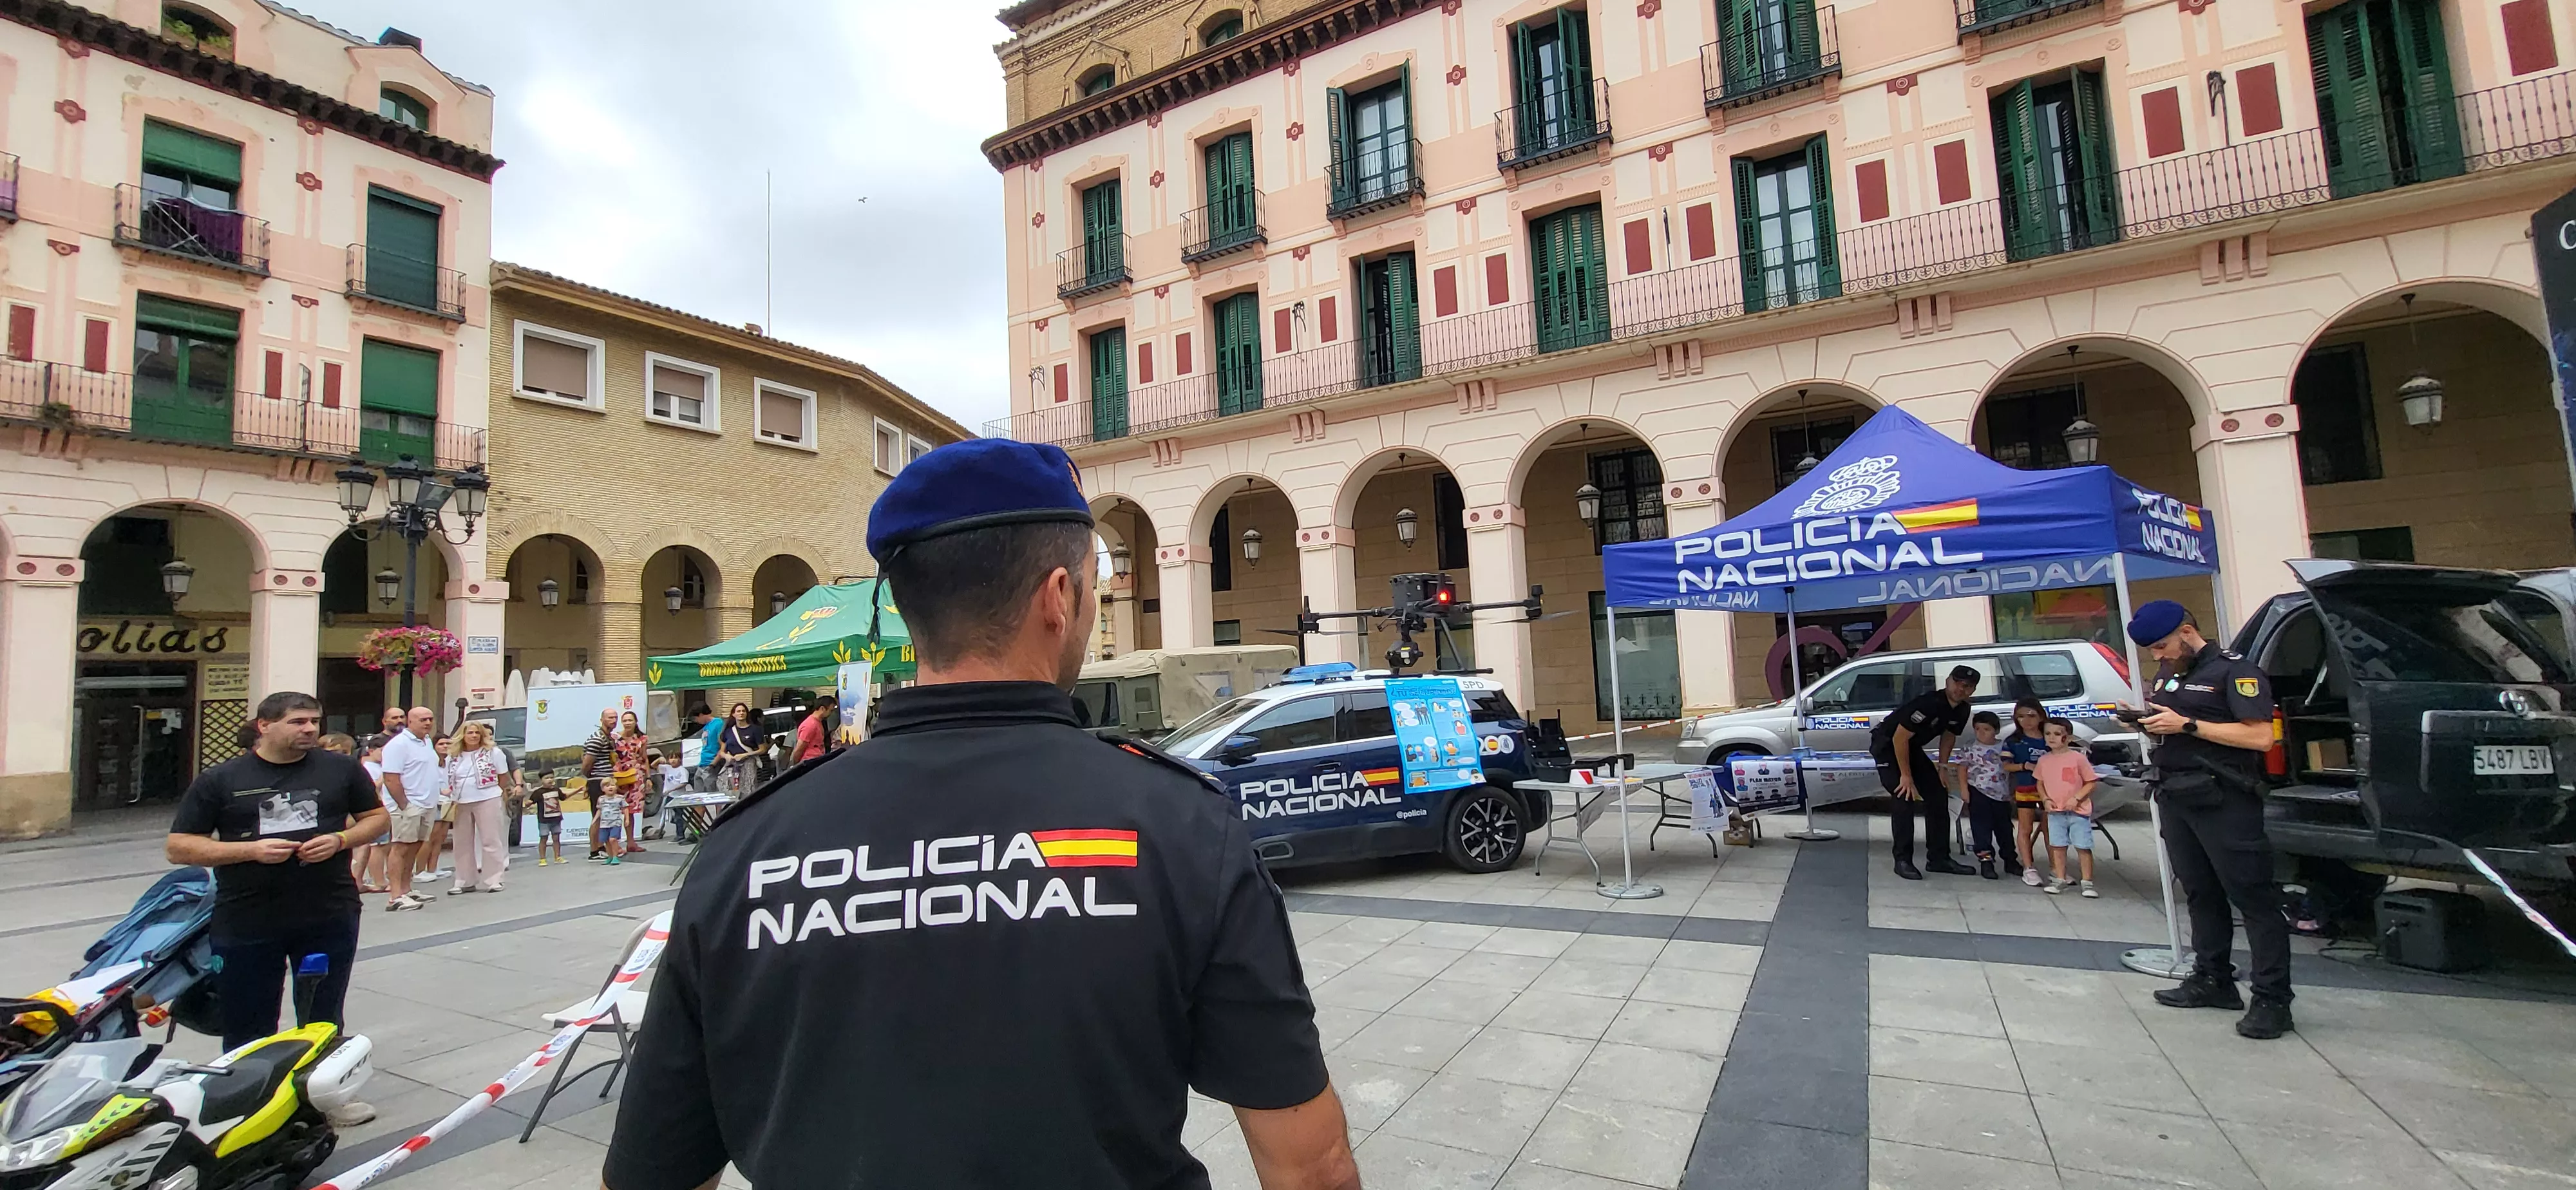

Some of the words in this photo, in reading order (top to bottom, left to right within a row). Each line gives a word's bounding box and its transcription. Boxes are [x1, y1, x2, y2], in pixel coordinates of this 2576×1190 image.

[2141, 522, 2206, 563] NACIONAL
[1677, 537, 1983, 593] NACIONAL
[699, 661, 739, 677] BRIGADA
[2050, 710, 2117, 719] NACIONAL
[2474, 749, 2514, 770] 5487
[1242, 788, 1401, 820] NACIONAL
[747, 876, 1137, 950] NACIONAL
